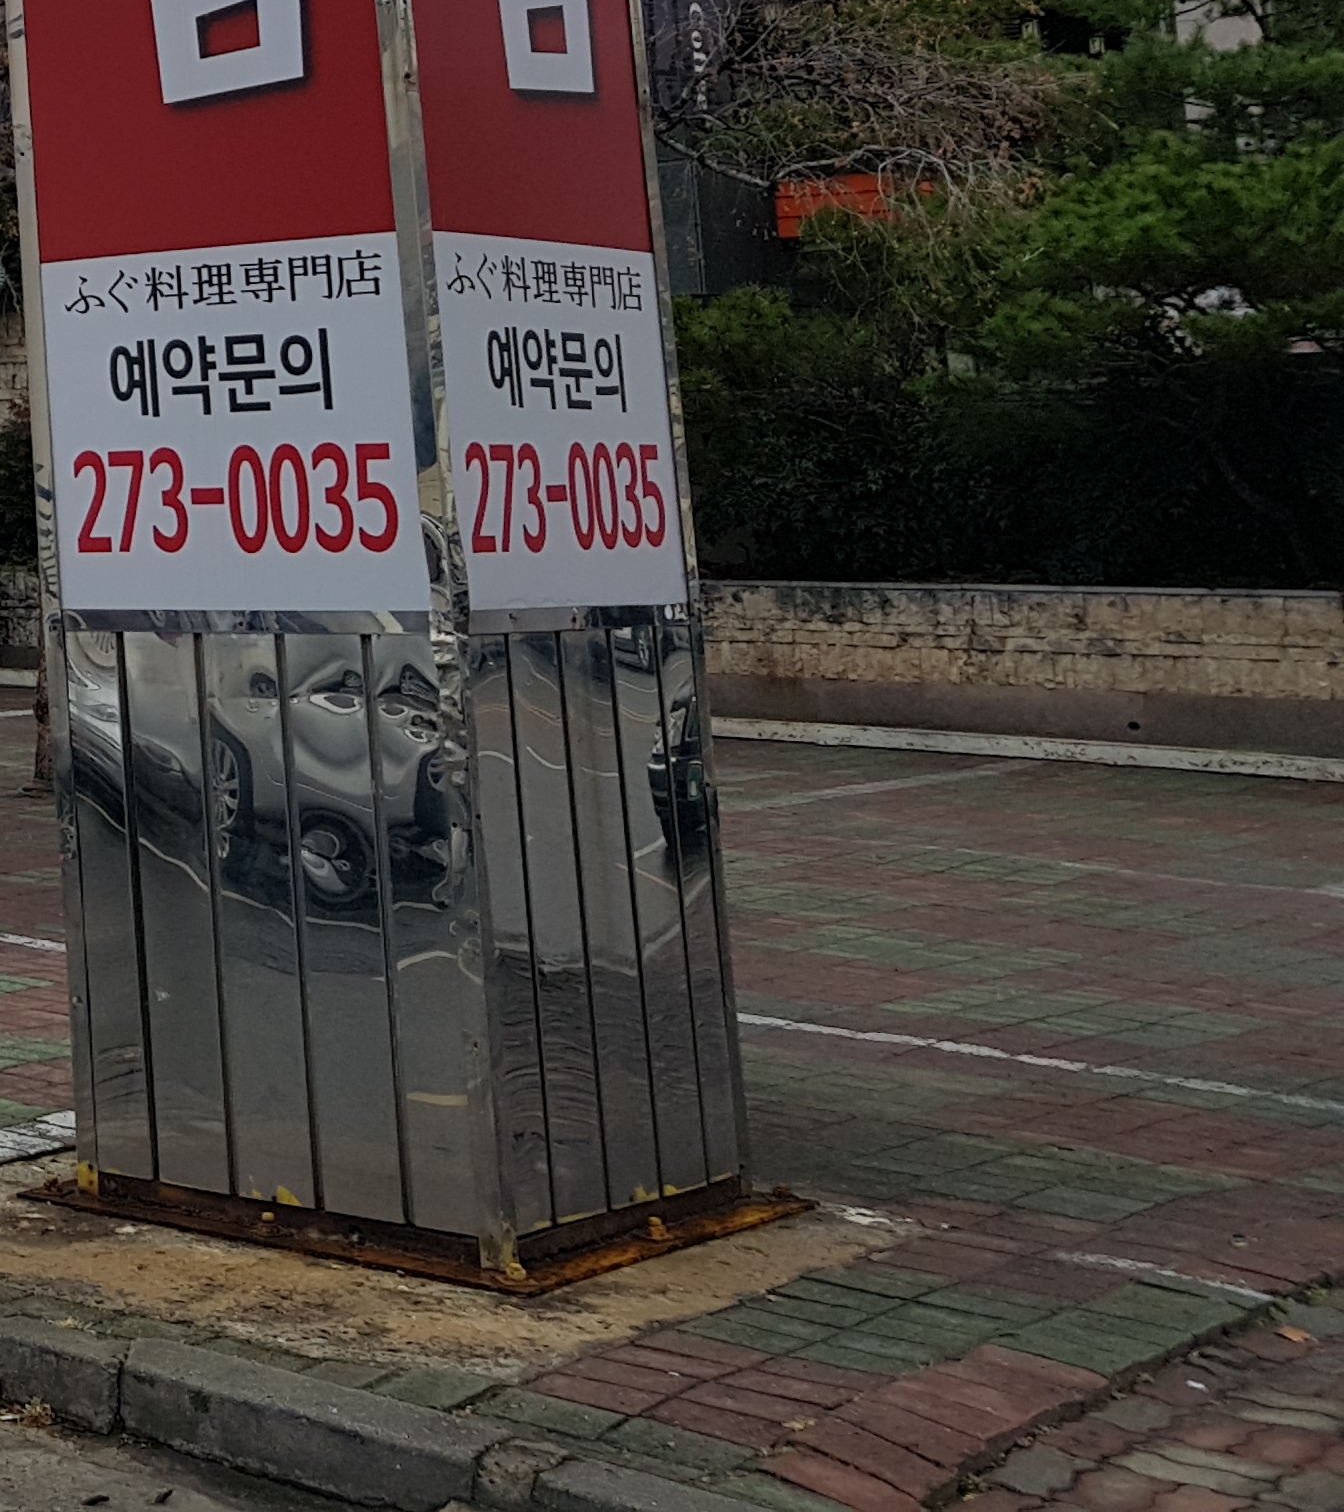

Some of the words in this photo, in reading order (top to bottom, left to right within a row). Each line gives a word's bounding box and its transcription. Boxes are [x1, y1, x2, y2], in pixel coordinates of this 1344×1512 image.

[64, 249, 382, 314] ふぐ料理専門店
[446, 252, 643, 312] ふぐ料理専門店
[110, 328, 334, 418] 예약문의
[487, 326, 628, 413] 예약문의
[73, 442, 399, 554] 273-0035
[465, 441, 666, 554] 273-0035
